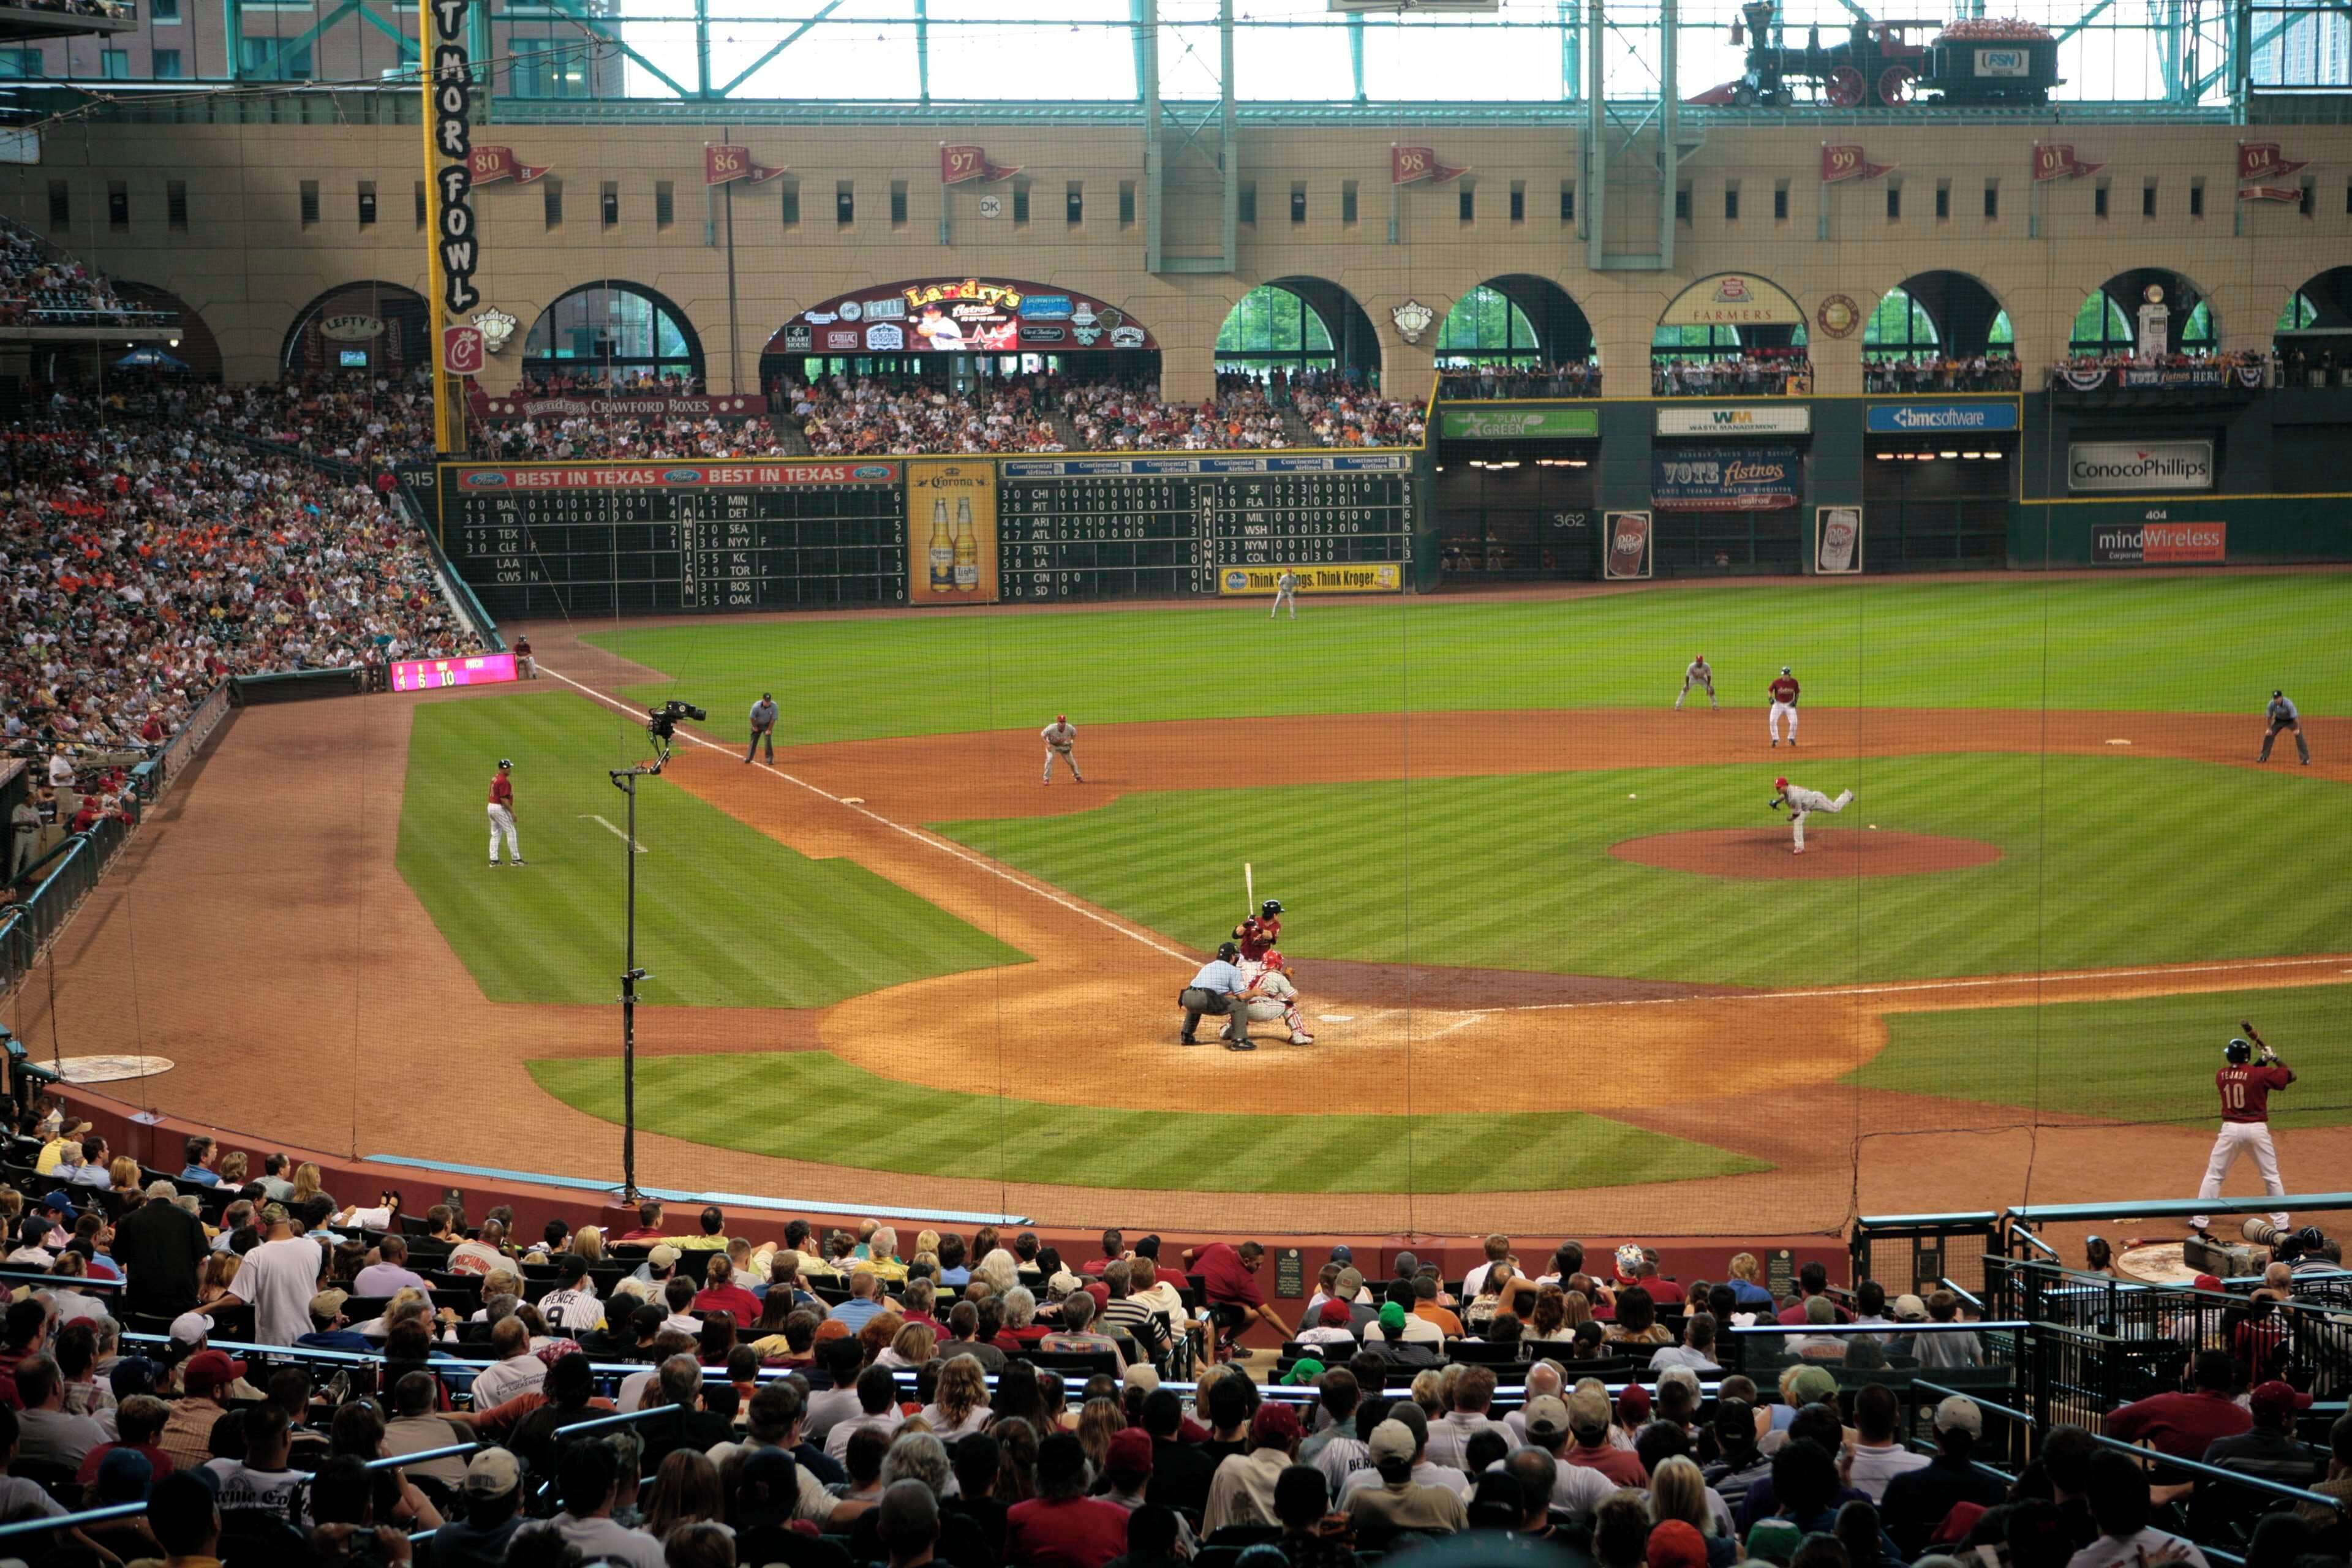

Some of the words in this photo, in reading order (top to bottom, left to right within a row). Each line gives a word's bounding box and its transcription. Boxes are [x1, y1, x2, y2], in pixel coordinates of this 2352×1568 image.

[475, 154, 499, 172] 80
[715, 154, 738, 172] 86
[951, 153, 974, 172] 97
[1400, 154, 1424, 170] 98
[1832, 151, 1855, 170] 99
[2043, 150, 2064, 168] 01
[2247, 149, 2270, 168] 04
[446, 173, 472, 306] FOWL
[905, 279, 1020, 308] Landry's
[1693, 310, 1773, 321] FARMERS
[2193, 371, 2220, 383] HERE
[591, 400, 665, 413] CRAWFORD
[668, 398, 709, 413] BOXES
[1497, 414, 1523, 424] PLAY
[1713, 411, 1753, 423] WM
[1482, 424, 1525, 435] GREEN
[1662, 462, 1720, 484] VOTE
[1724, 460, 1785, 487] Astros
[2074, 458, 2206, 480] ConocoPhillips
[403, 472, 434, 487] 315
[476, 475, 500, 486] Ford
[515, 472, 562, 486] BEST
[567, 472, 588, 485] IN
[594, 470, 656, 484] TEXAS
[669, 471, 693, 481] Ford
[709, 468, 754, 483] BEST
[760, 468, 780, 483] IN
[785, 467, 845, 481] TEXAS
[859, 468, 883, 478] Ford
[931, 475, 974, 489] Corona
[1032, 489, 1049, 499] CHI
[1190, 486, 1196, 496] 5
[1250, 484, 1260, 495] SF
[1404, 482, 1411, 492] 6
[497, 499, 518, 511] BAL
[669, 497, 676, 507] 4
[728, 496, 748, 505] MIN
[894, 492, 901, 502] 6
[1033, 502, 1048, 511] PIT
[1190, 498, 1196, 509] 5
[1246, 497, 1264, 507] FLA
[1404, 494, 1411, 504] 8
[501, 513, 514, 524] TB
[669, 509, 676, 520] 4
[729, 508, 748, 519] DET
[895, 505, 899, 515] 1
[1247, 513, 1265, 522] MIL
[1404, 509, 1411, 519] 6
[2146, 510, 2167, 520] 404
[729, 524, 748, 534] SEA
[895, 520, 901, 530] 5
[1033, 517, 1049, 527] ARI
[1191, 514, 1197, 524] 7
[1553, 514, 1587, 527] 362
[498, 529, 518, 540] TEX
[670, 525, 677, 536] 2
[1033, 530, 1050, 540] ATL
[1191, 526, 1197, 537] 3
[1245, 525, 1267, 535] WSH
[1404, 522, 1411, 532] 6
[499, 542, 517, 553] CLE
[671, 538, 676, 549] 1
[729, 537, 750, 547] NYY
[895, 533, 902, 543] 6
[1203, 497, 1213, 581] NATIONAL
[1245, 540, 1267, 550] NYM
[1405, 537, 1409, 547] 1
[2099, 529, 2220, 549] mindWireless
[682, 507, 694, 595] AMERICAN
[734, 552, 747, 563] KC
[896, 549, 901, 559] 1
[1033, 545, 1049, 556] STL
[1190, 542, 1197, 552] 0
[1247, 552, 1266, 563] COL
[1405, 549, 1411, 559] 3
[497, 558, 520, 569] LAA
[1035, 558, 1047, 568] LA
[1191, 554, 1197, 564] 0
[730, 565, 750, 576] TOR
[896, 561, 902, 571] 3
[497, 571, 521, 582] CWS
[1034, 573, 1050, 583] CIN
[1191, 569, 1197, 579] 0
[1249, 572, 1275, 588] Think
[1316, 571, 1341, 587] Think
[1343, 570, 1377, 587] Kroger.
[731, 581, 750, 592] BOS
[897, 578, 901, 587] 1
[1036, 586, 1048, 596] SD
[1191, 582, 1198, 592] 0
[730, 594, 752, 605] OAK
[896, 590, 903, 600] 0
[398, 675, 406, 690] 4
[418, 674, 426, 688] 6
[440, 670, 456, 687] 10
[2221, 1071, 2248, 1081] TEJADA
[2223, 1083, 2245, 1109] 10
[544, 1294, 579, 1305] PENCE
